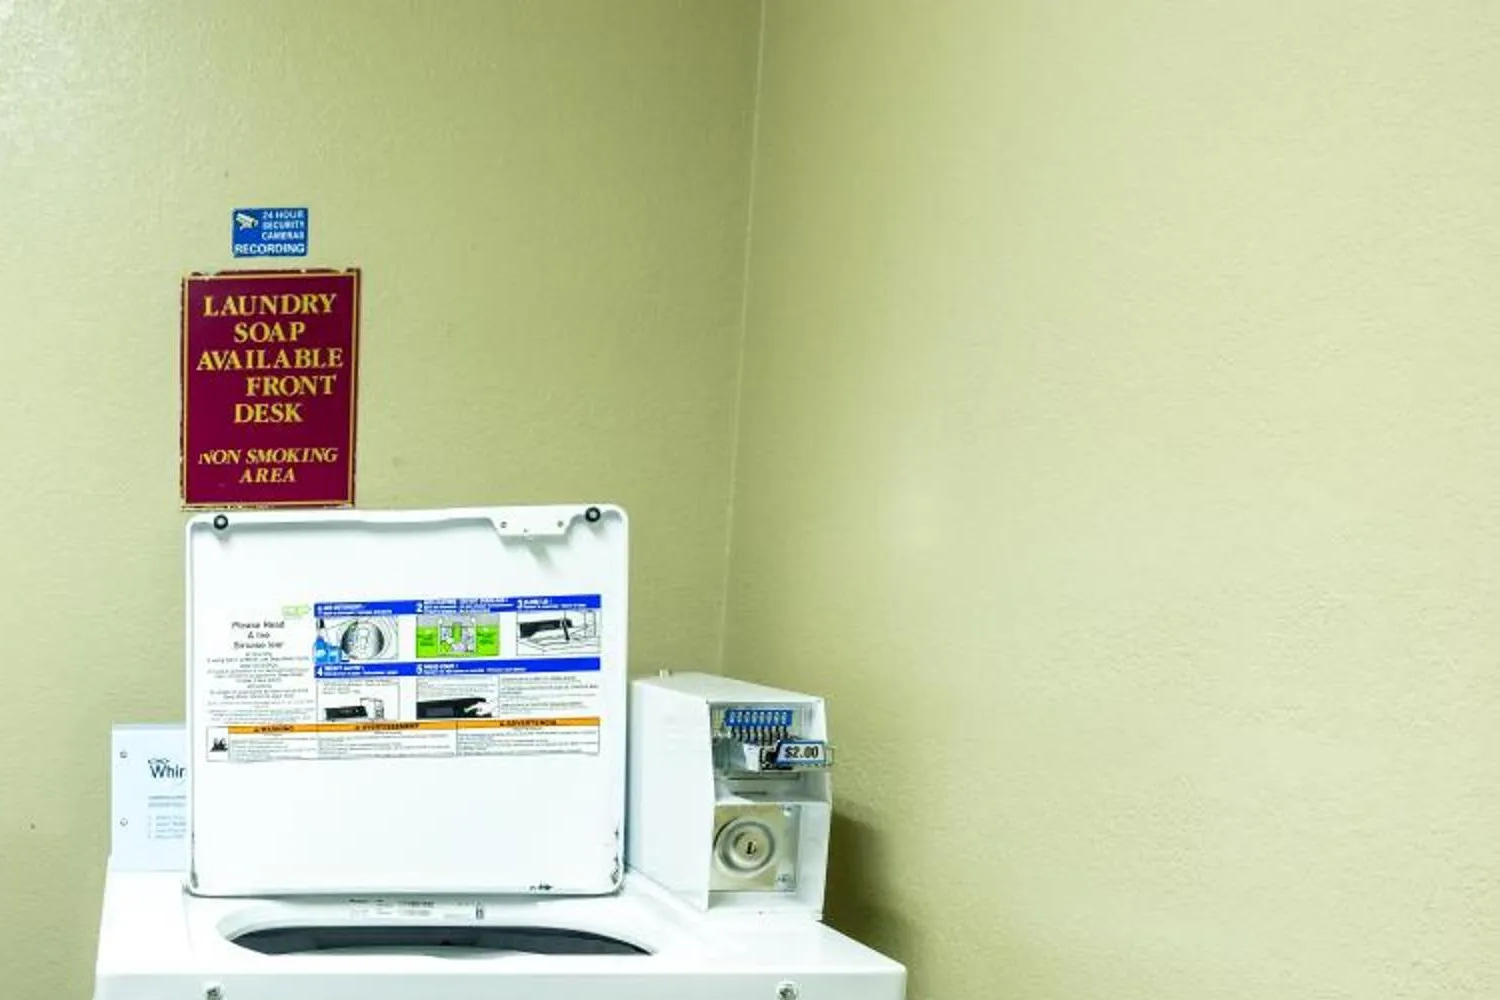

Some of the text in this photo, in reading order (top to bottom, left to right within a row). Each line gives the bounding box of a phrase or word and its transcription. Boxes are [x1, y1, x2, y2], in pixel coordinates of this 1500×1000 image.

[261, 209, 305, 219] 24 HOUR
[262, 221, 304, 230] SECURITY
[261, 231, 305, 241] CAMERAS
[235, 243, 305, 254] RECORDING
[203, 293, 337, 317] LAUNDRY
[233, 321, 306, 343] SOAP
[196, 348, 343, 371] AVAILABLE
[246, 375, 337, 397] FRONT
[233, 403, 304, 424] DESK
[198, 447, 339, 465] NON SMOKING
[239, 467, 297, 484] AREA
[784, 745, 819, 759] $2.00
